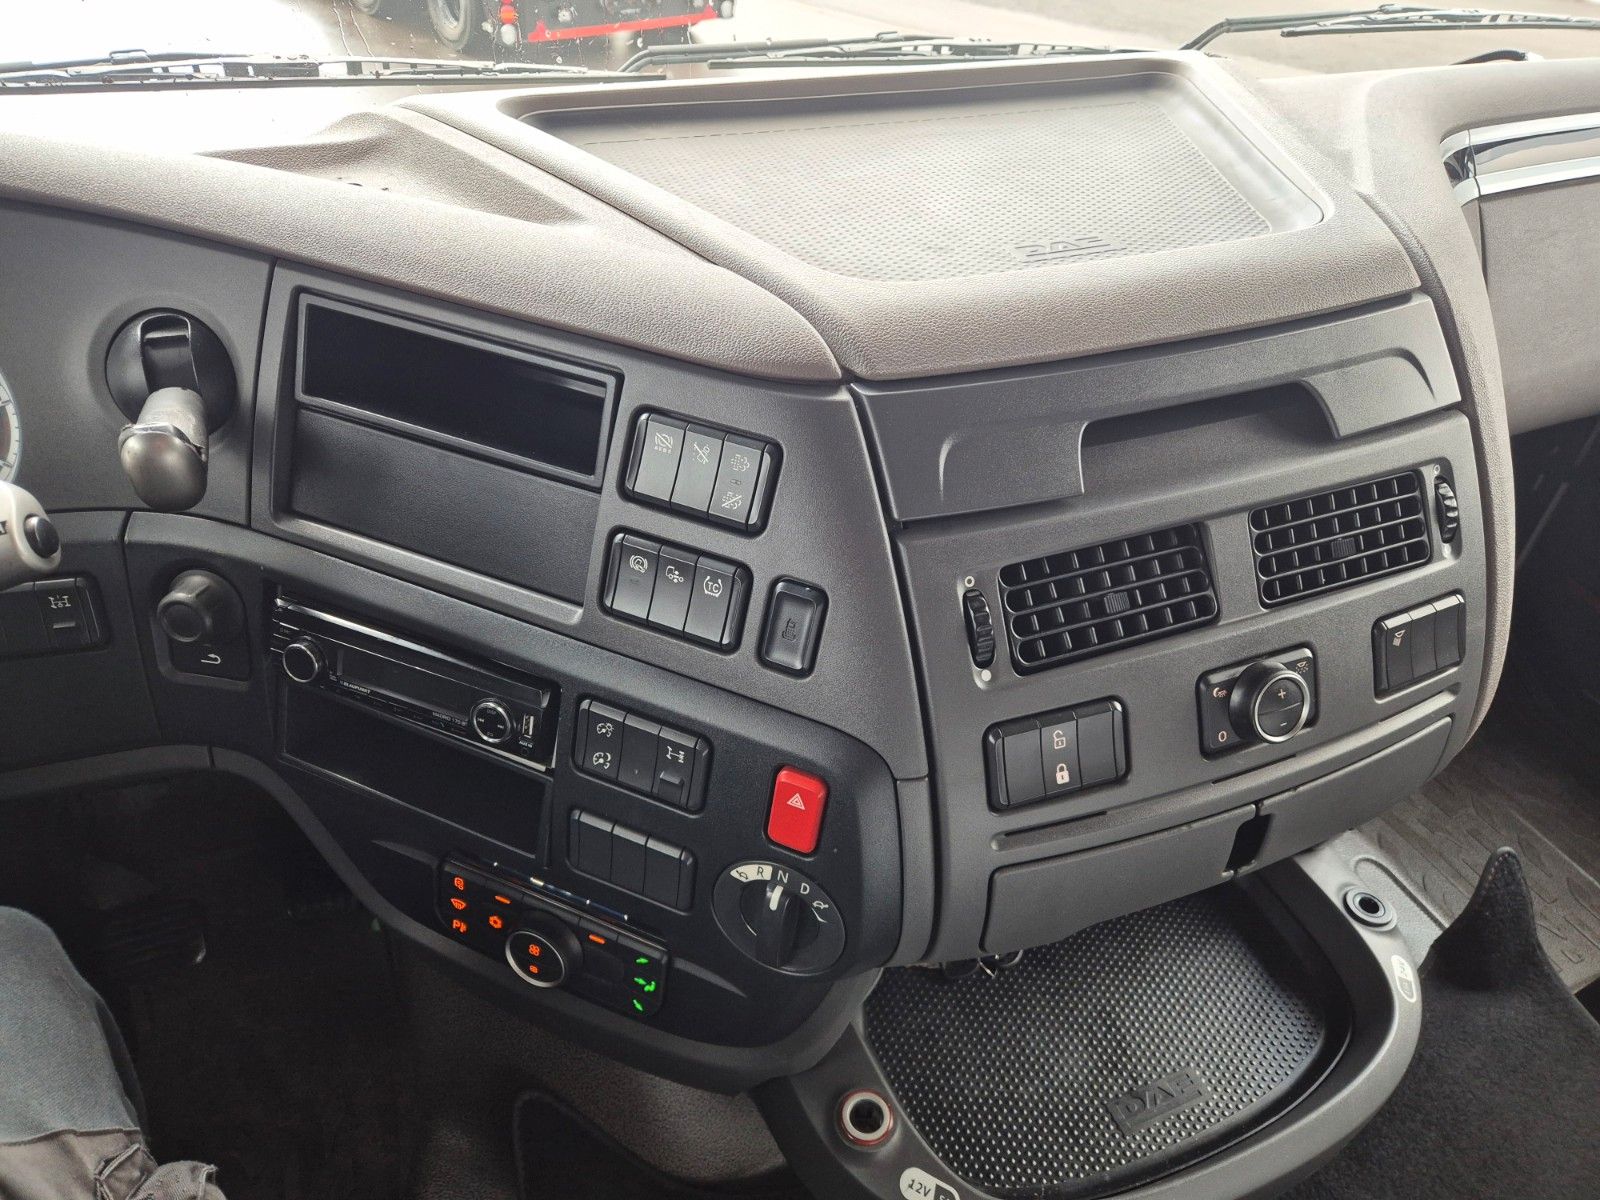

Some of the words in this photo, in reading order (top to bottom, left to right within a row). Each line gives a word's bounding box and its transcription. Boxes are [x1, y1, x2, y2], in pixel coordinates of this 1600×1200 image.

[707, 581, 719, 593] TC
[756, 866, 764, 879] R
[777, 869, 789, 884] N
[800, 882, 810, 895] D
[907, 1179, 931, 1197] 12V
